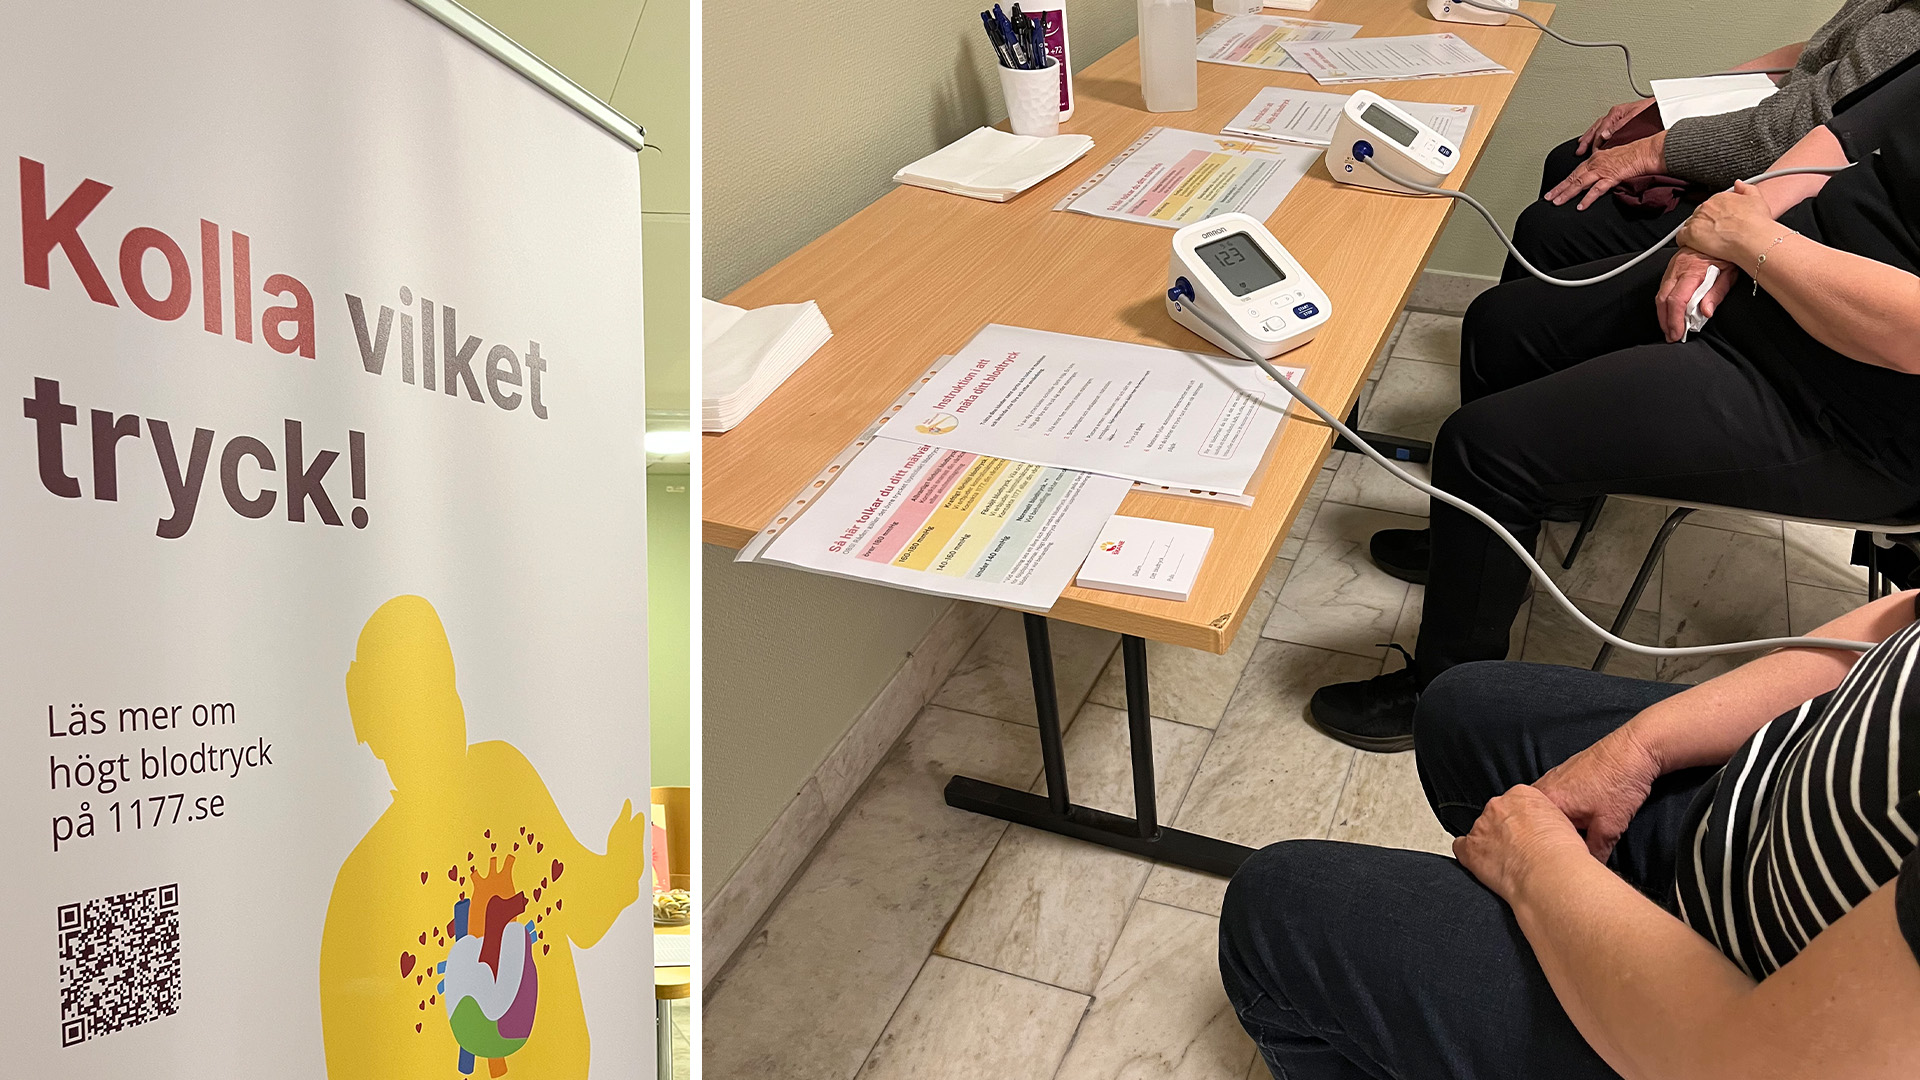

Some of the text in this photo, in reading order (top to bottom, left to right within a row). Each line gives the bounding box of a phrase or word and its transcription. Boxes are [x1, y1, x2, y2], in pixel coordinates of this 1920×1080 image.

[1214, 247, 1245, 267] 123
[19, 155, 549, 421] Kolla vilket
[933, 372, 977, 409] Instruktion
[976, 359, 990, 369] att
[956, 351, 1020, 413] mäta ditt blodtryck
[22, 376, 369, 539] tryck!
[829, 541, 846, 552] Så
[840, 524, 860, 539] här
[856, 498, 883, 523] tolkar
[880, 485, 894, 497] du
[890, 470, 908, 484] ditt
[862, 545, 875, 557] över
[872, 536, 884, 545] 180
[898, 542, 919, 562] 160-180
[936, 551, 956, 570] 140-160
[975, 562, 989, 577] under
[985, 552, 997, 561] 140
[48, 701, 236, 737] Läs mer om
[50, 736, 273, 794] högt blodtryck
[52, 793, 225, 852] på 1177.se
